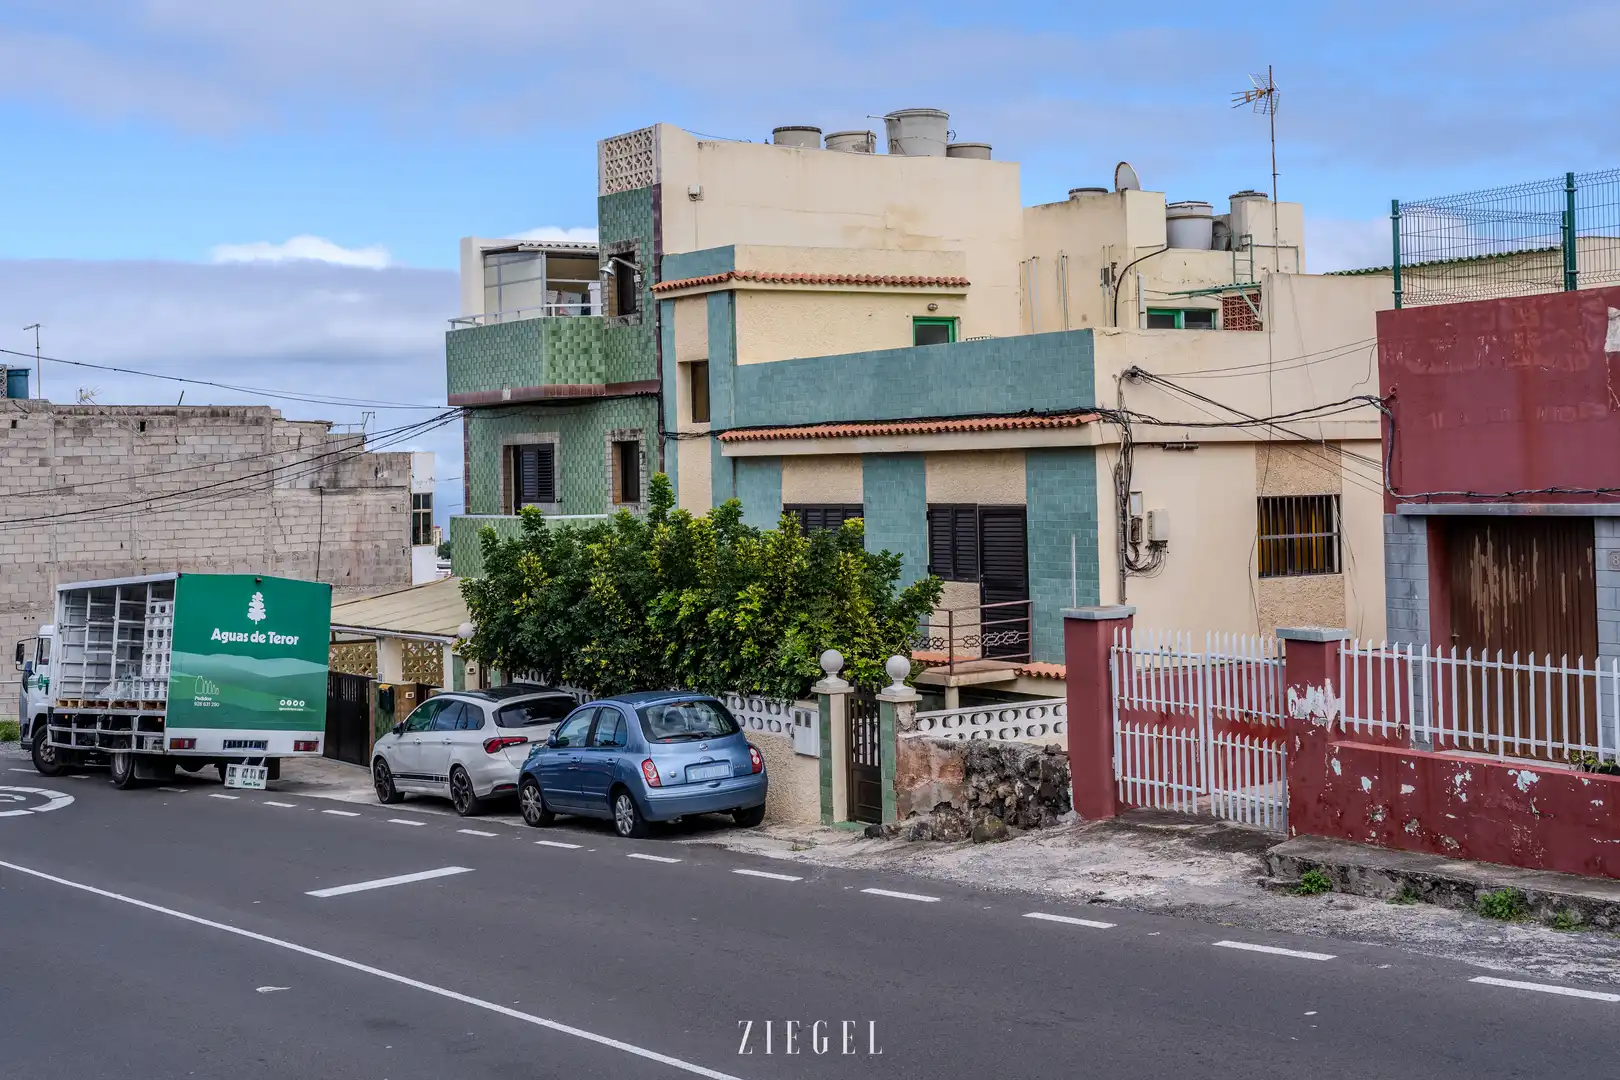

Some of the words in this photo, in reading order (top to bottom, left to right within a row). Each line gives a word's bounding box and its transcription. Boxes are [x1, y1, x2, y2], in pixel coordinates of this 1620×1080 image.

[210, 627, 249, 644] Aguas
[250, 630, 267, 644] de
[267, 631, 299, 645] Teror
